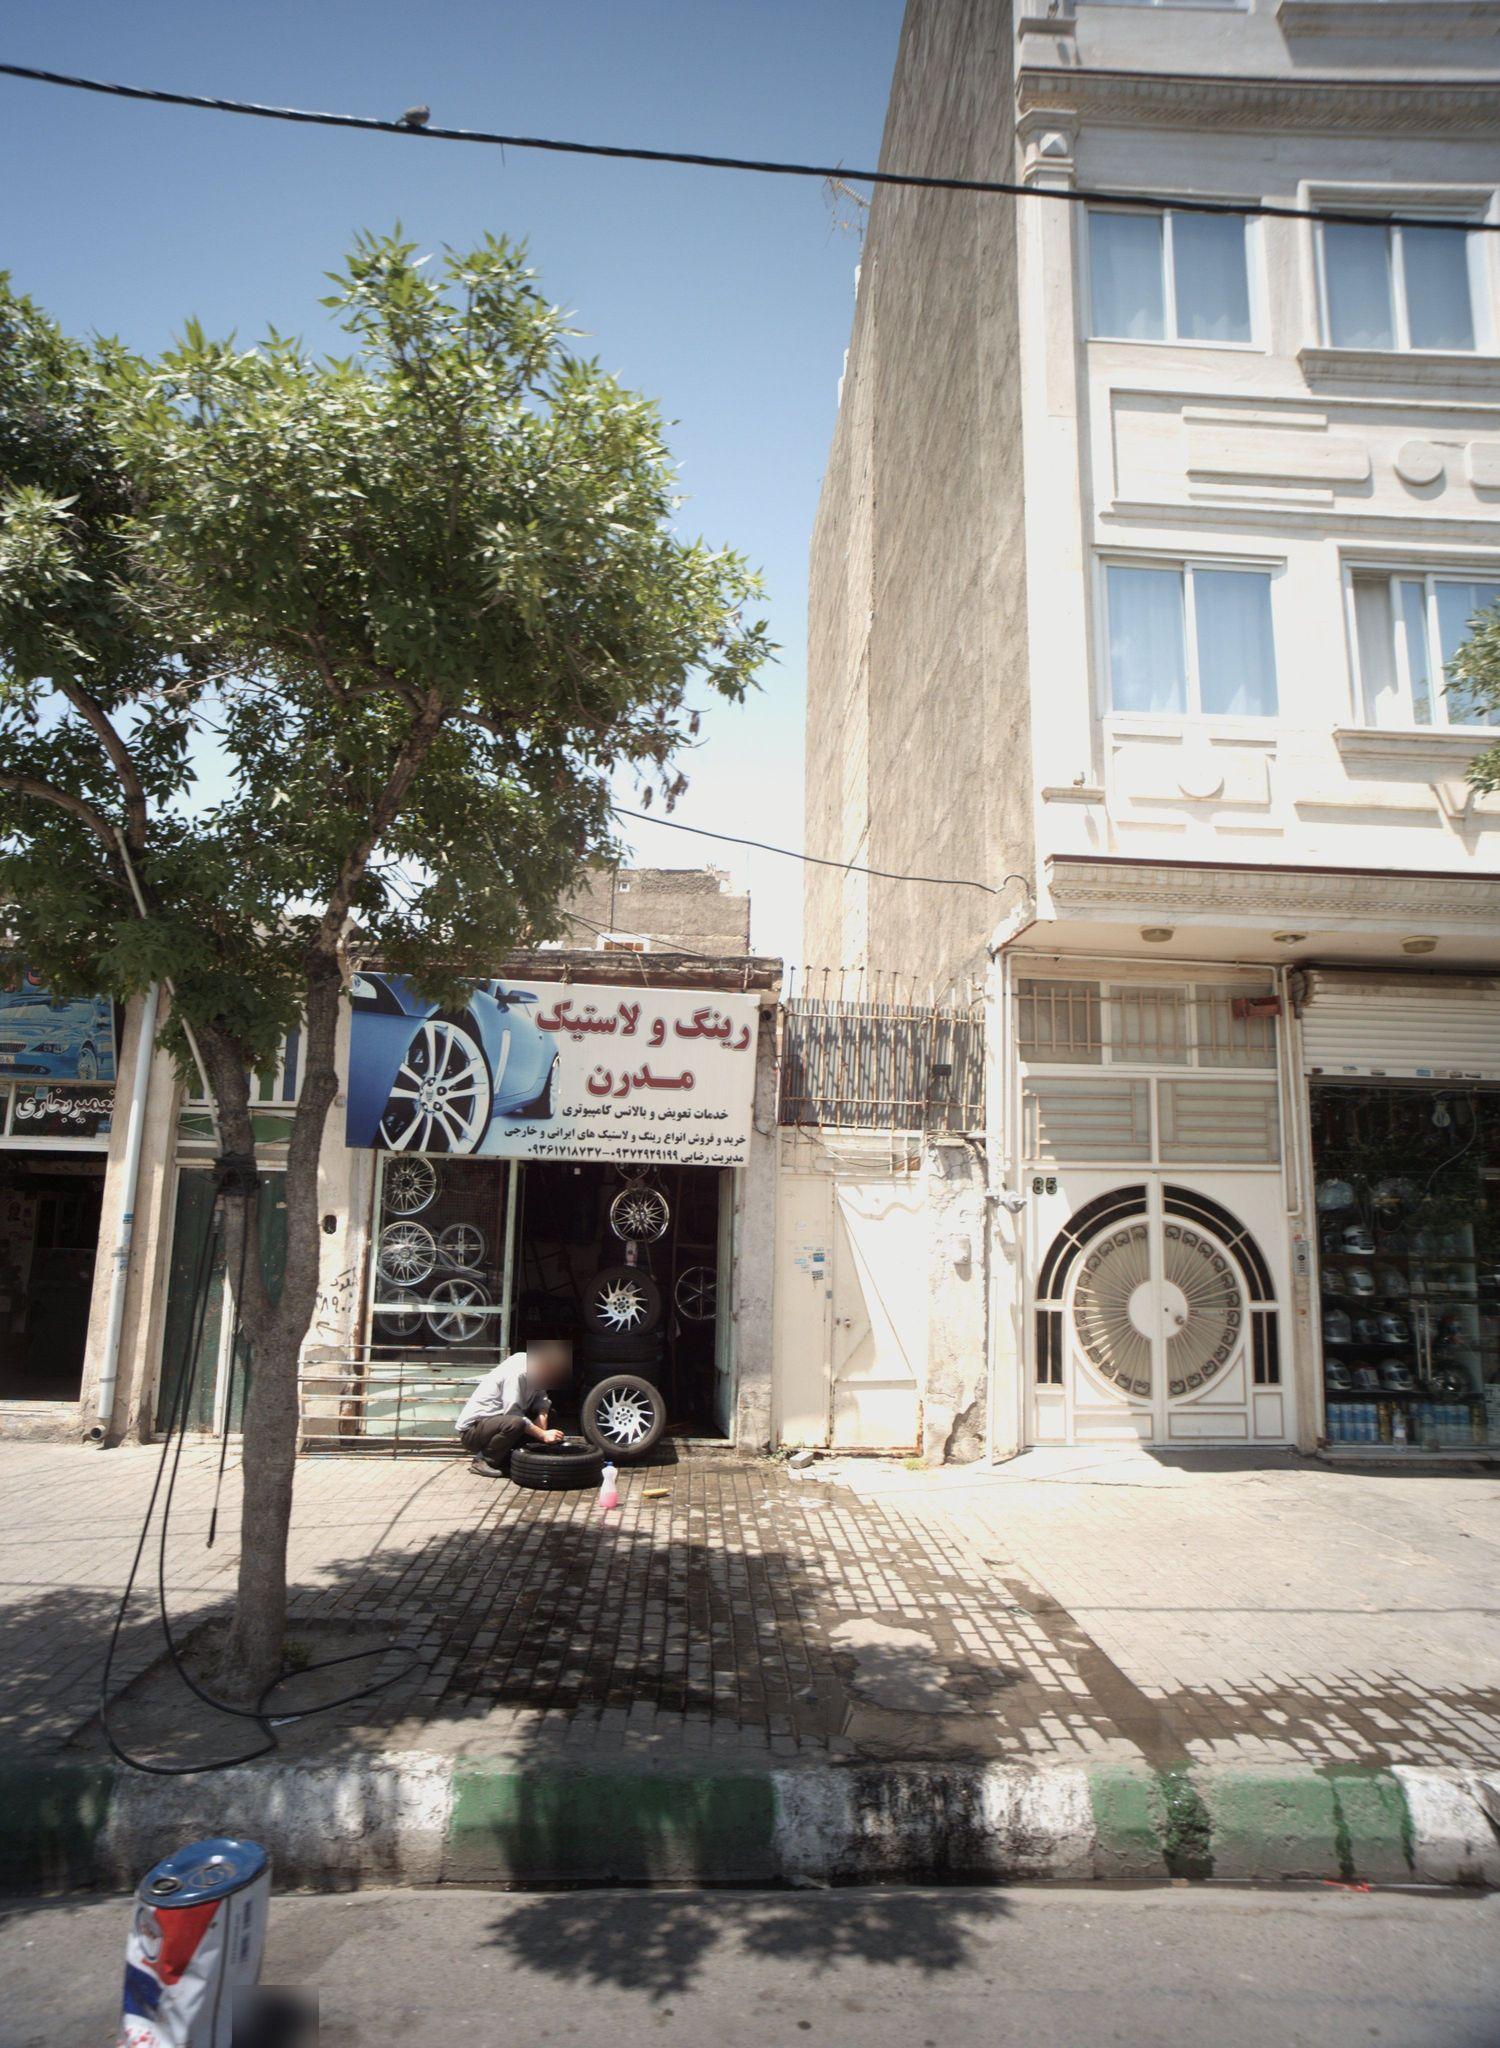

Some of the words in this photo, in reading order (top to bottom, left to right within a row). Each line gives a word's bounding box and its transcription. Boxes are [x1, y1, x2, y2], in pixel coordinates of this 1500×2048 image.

[535, 999, 642, 1041] لاستیک
[647, 1017, 666, 1047] و
[673, 1006, 751, 1050] رینگ
[586, 1062, 695, 1098] مدرن
[15, 1087, 73, 1124] بخاری
[562, 1104, 612, 1118] کامپیوتری
[614, 1104, 647, 1119] بالانس
[649, 1110, 655, 1120] و
[658, 1107, 691, 1121] تعویض
[694, 1109, 729, 1120] خدمات
[504, 1125, 537, 1138] خارجی
[540, 1129, 545, 1138] و
[547, 1127, 575, 1140] ایرانی
[577, 1129, 595, 1140] های
[597, 1129, 629, 1141] لاستیک
[631, 1133, 636, 1142] و
[638, 1131, 661, 1143] رینگ
[663, 1132, 686, 1144] انواع
[688, 1132, 714, 1146] فروش
[716, 1136, 721, 1146] و
[723, 1135, 746, 1146] خرید
[681, 1151, 709, 1163] رضایی
[711, 1152, 744, 1164] مدیریت
[1032, 1176, 1057, 1195] 85
